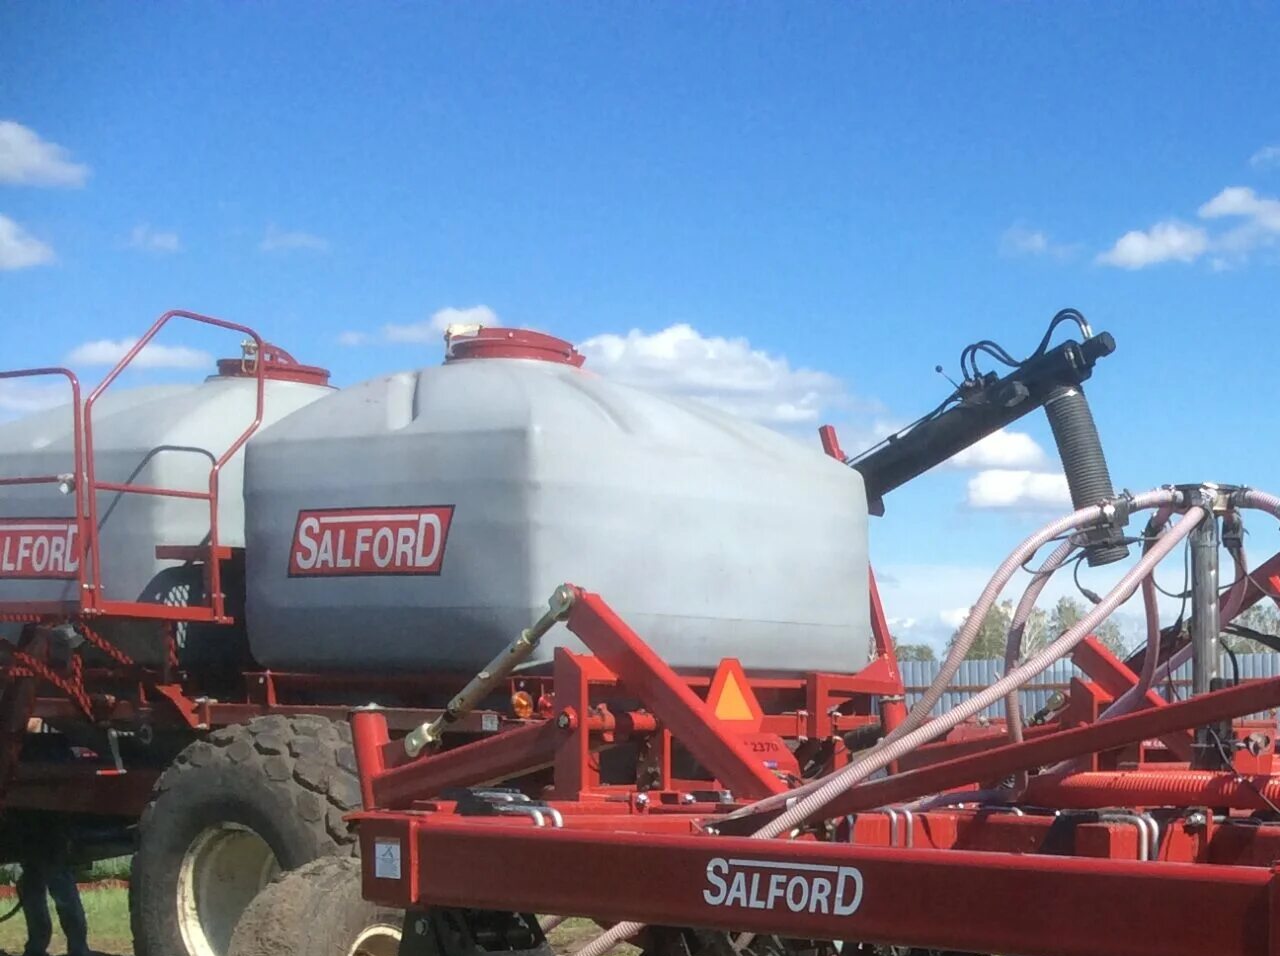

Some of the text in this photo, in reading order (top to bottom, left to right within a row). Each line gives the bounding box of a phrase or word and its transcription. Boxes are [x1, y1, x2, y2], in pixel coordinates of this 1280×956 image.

[0, 524, 80, 573] LFORD
[296, 513, 442, 570] SALFORD
[702, 857, 864, 916] SALFORD
